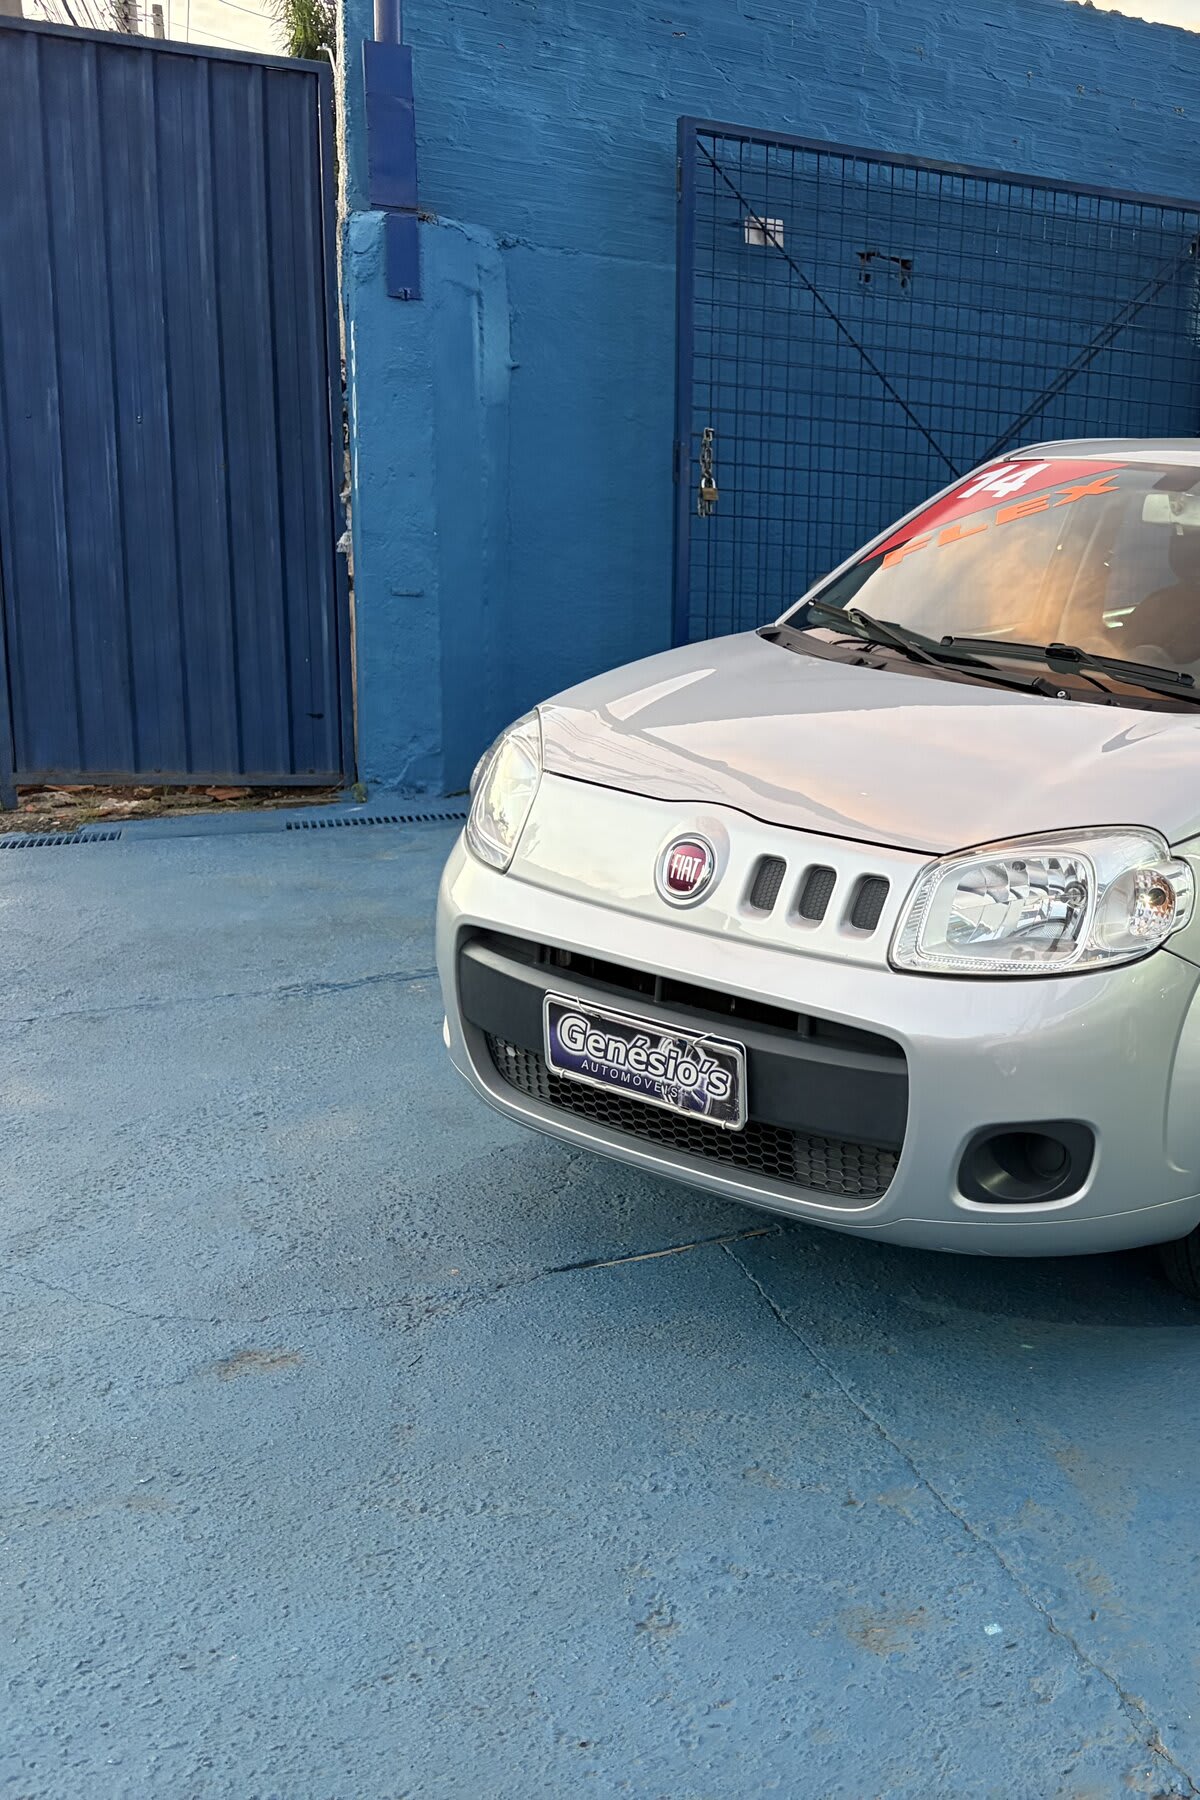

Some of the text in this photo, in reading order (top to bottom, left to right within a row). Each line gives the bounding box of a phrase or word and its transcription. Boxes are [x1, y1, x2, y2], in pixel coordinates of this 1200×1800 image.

[957, 463, 1052, 499] 14
[881, 474, 1120, 571] FLEX
[670, 853, 702, 884] FIAT
[557, 1012, 731, 1099] Genésio's
[581, 1059, 679, 1098] AUTOMÓVEIS
